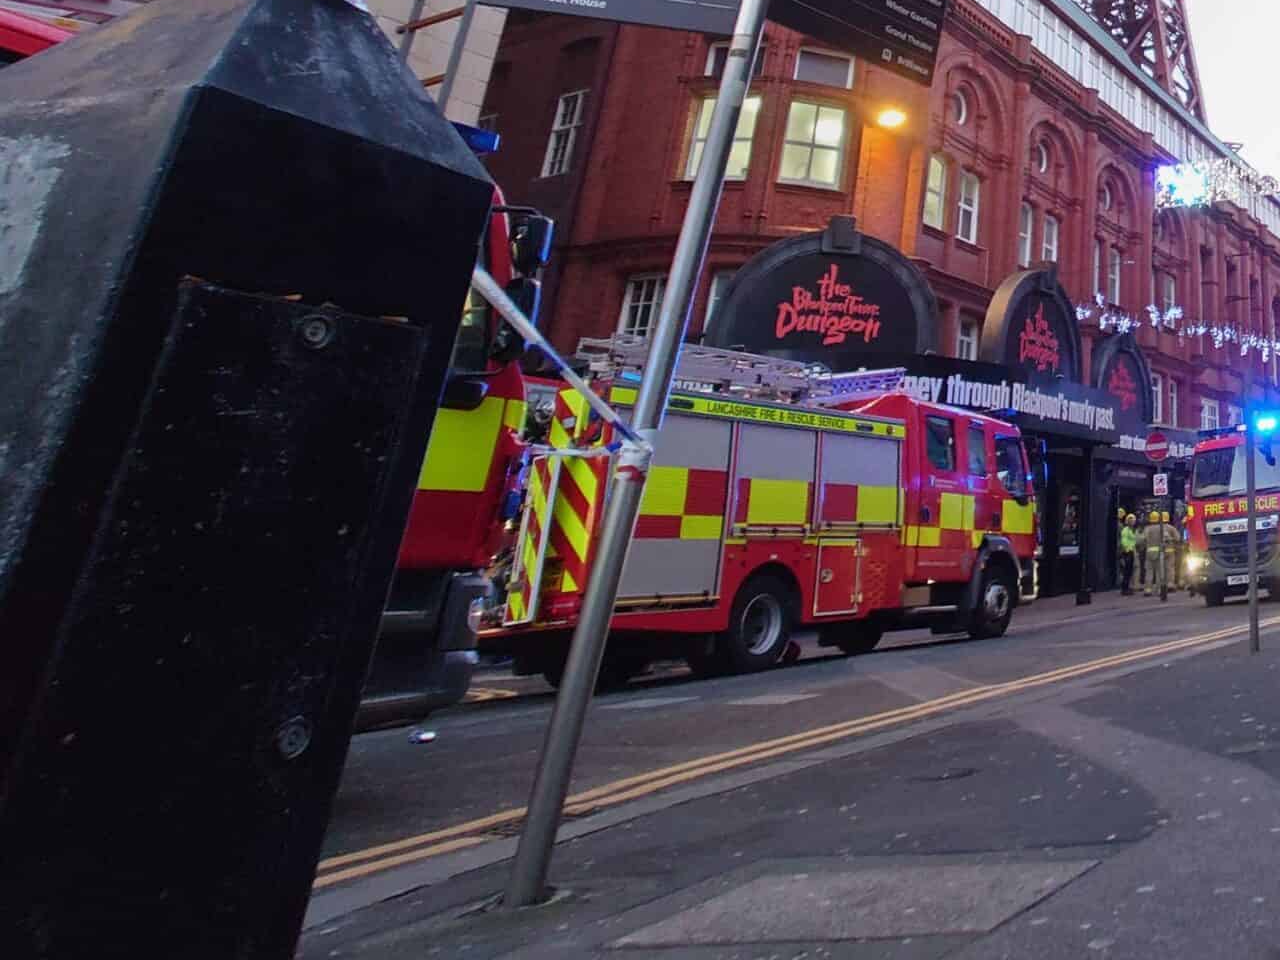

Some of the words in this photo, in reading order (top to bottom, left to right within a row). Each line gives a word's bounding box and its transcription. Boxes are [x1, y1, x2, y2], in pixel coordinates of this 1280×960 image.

[816, 263, 850, 299] the
[776, 302, 881, 346] Dungeon
[706, 401, 757, 419] LANCASHIRE
[759, 406, 775, 420] FIRE
[777, 409, 784, 421] &
[785, 410, 816, 426] RESCUE
[818, 415, 846, 429] SERVICE
[947, 374, 1011, 409] through
[1012, 382, 1068, 421] Blackpool's
[1068, 399, 1095, 430] murky
[1204, 503, 1225, 516] FIRE
[1228, 502, 1235, 513] &
[1239, 496, 1279, 512] RCUE
